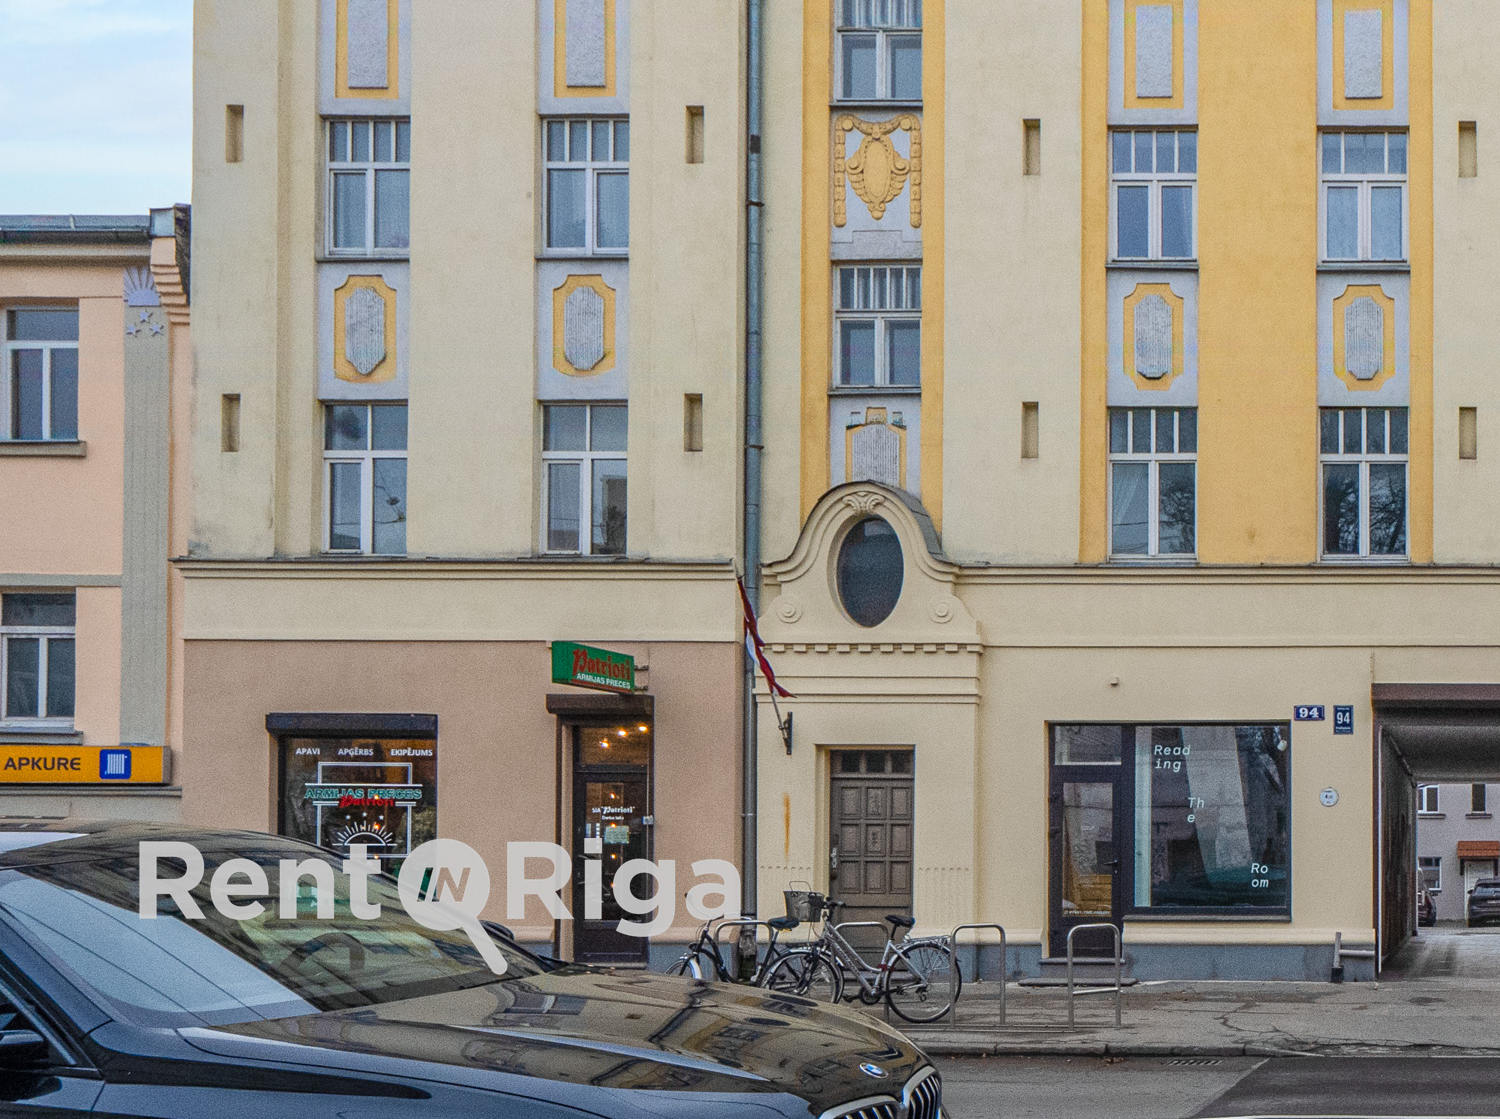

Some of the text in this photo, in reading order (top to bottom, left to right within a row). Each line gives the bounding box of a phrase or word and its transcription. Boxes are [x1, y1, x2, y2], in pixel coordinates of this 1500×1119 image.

[572, 649, 631, 681] Patrioti
[576, 672, 631, 690] ARMIJAS PRECES
[1298, 707, 1320, 719] 94
[1336, 711, 1351, 724] 94
[295, 747, 433, 758] APAVI APĢĒRBS EKIPĒJUMS
[1153, 744, 1191, 756] Read
[4, 757, 81, 771] APKURE
[1154, 758, 1182, 773] ing
[304, 788, 423, 799] ARMIJAS PRECES
[1187, 797, 1205, 809] Th
[1187, 814, 1196, 823] e
[1251, 862, 1269, 874] Ro
[1251, 878, 1269, 888] om
